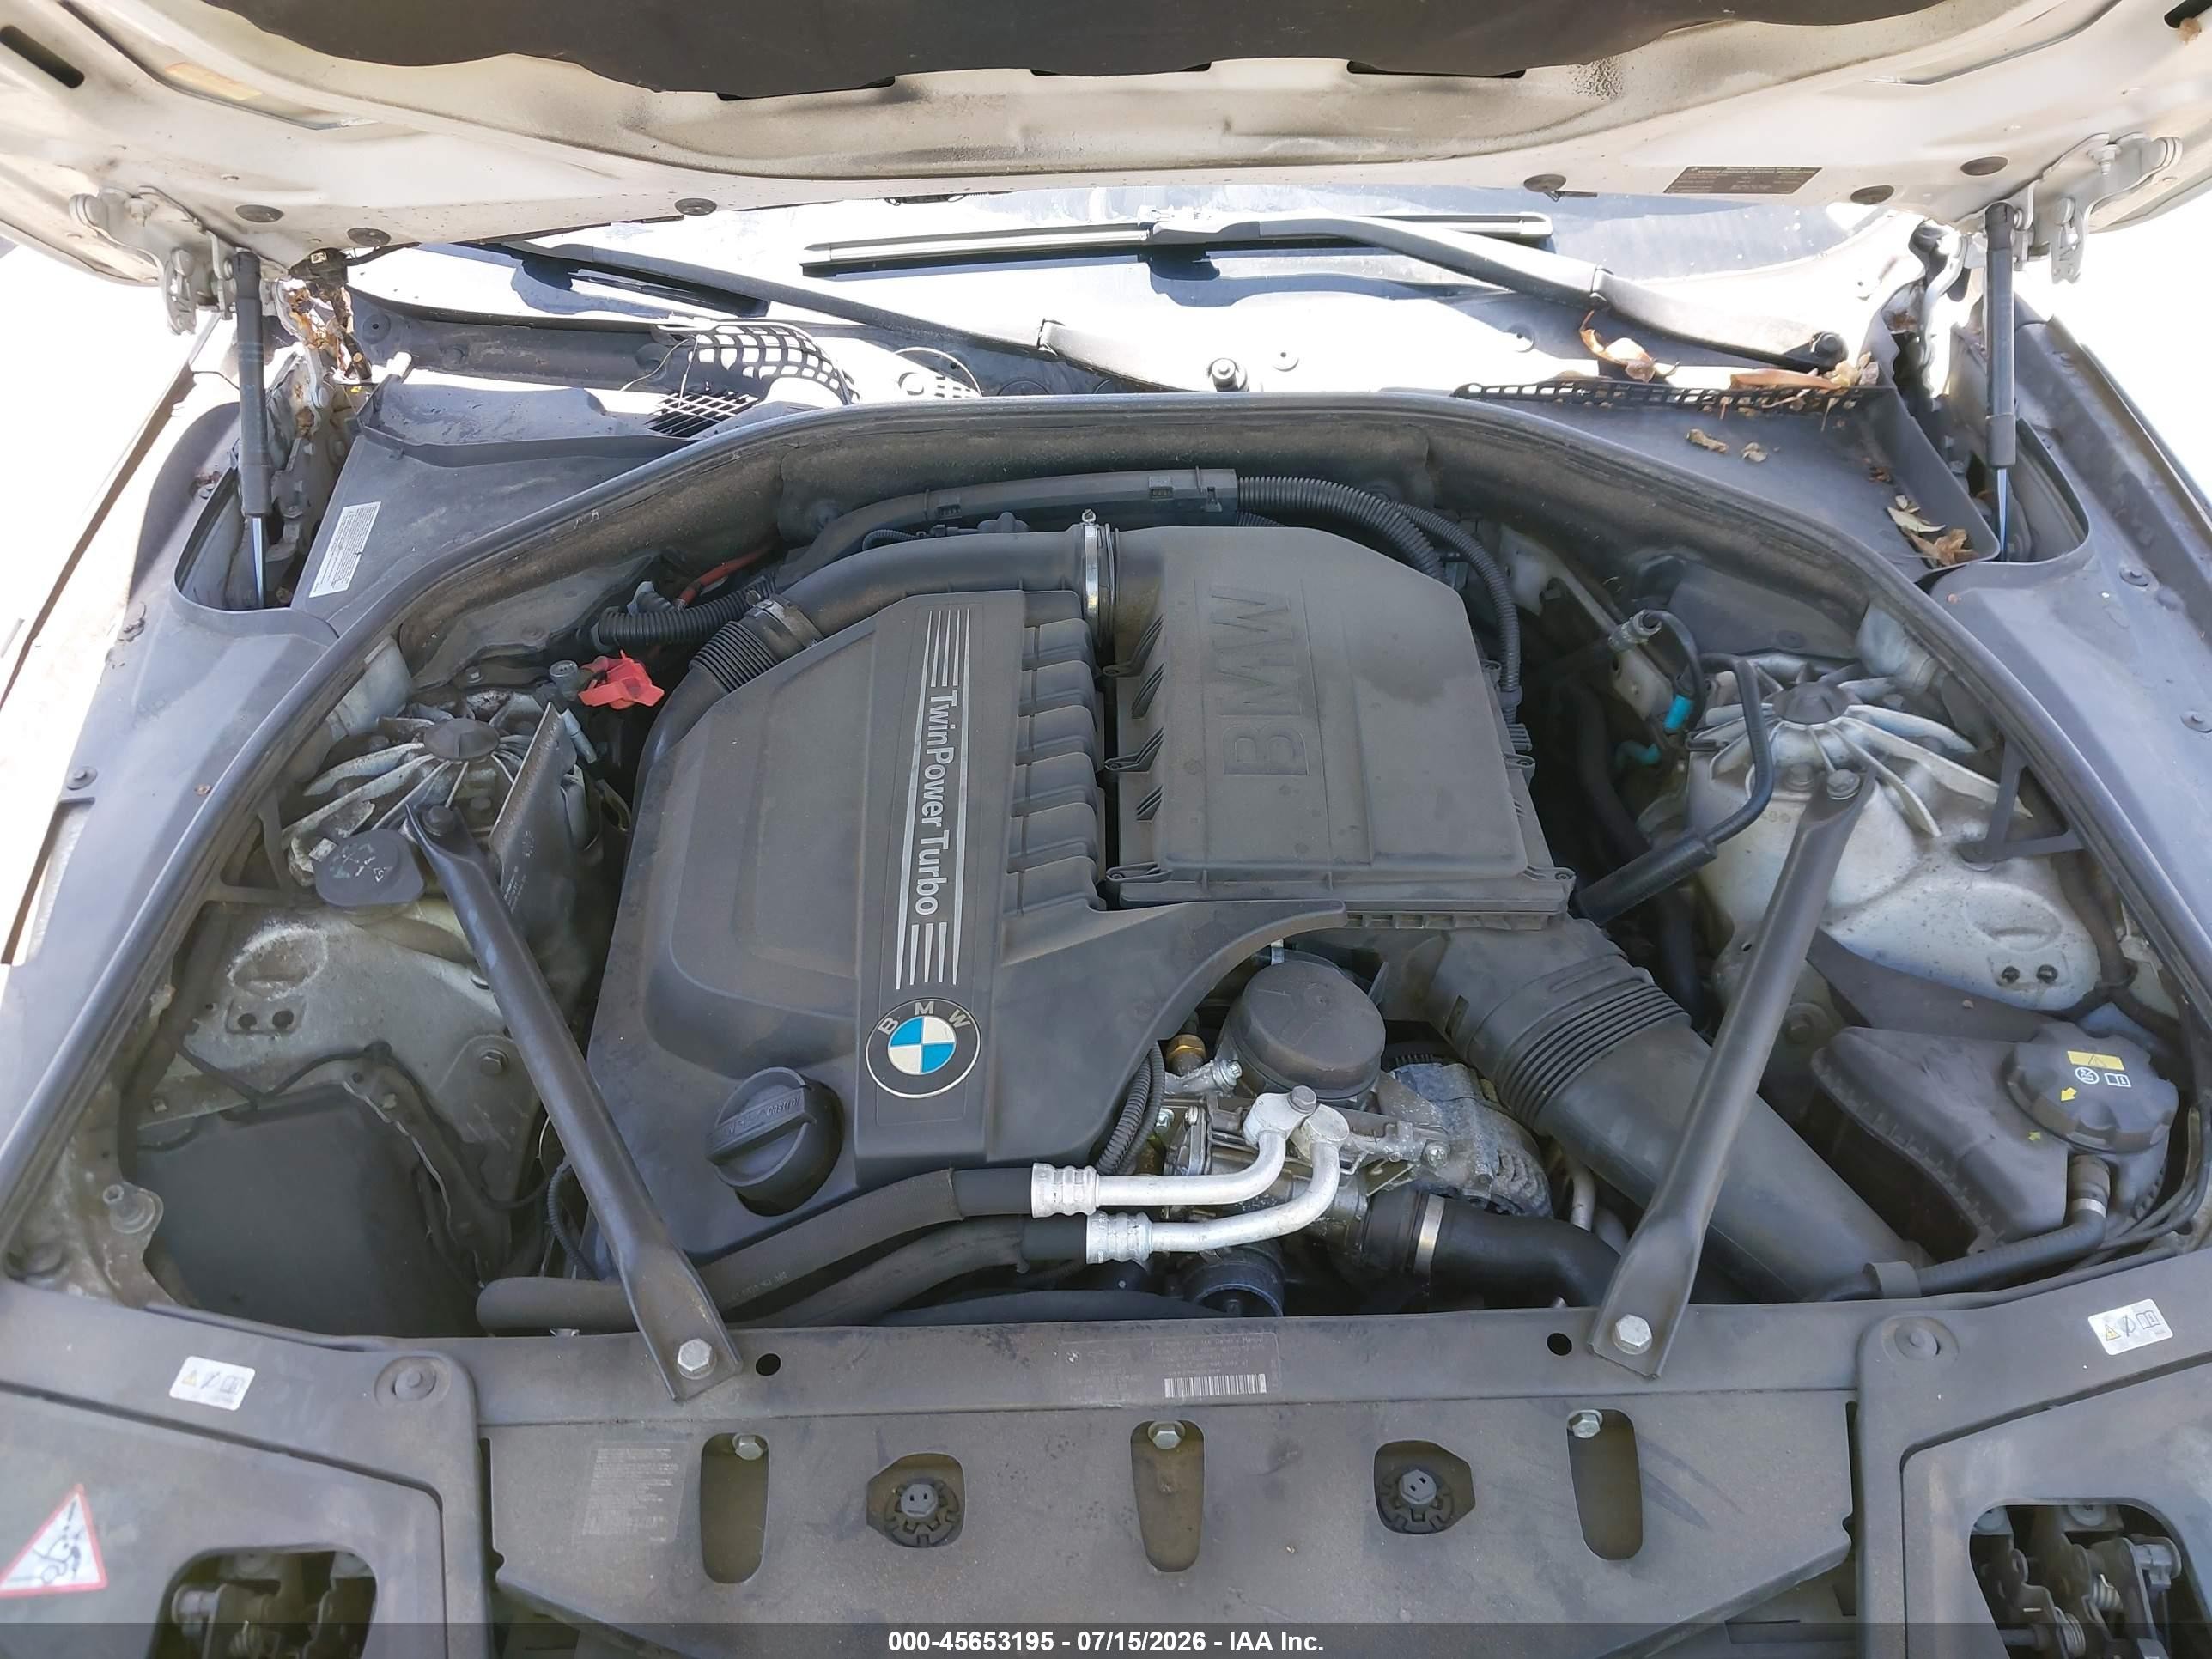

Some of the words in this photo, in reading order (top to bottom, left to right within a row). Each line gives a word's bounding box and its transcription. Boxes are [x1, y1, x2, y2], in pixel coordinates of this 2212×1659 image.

[1209, 586, 1309, 776] BMW
[921, 690, 958, 828] TwinPower
[915, 830, 951, 916] Turbo
[877, 1000, 971, 1036] BMW
